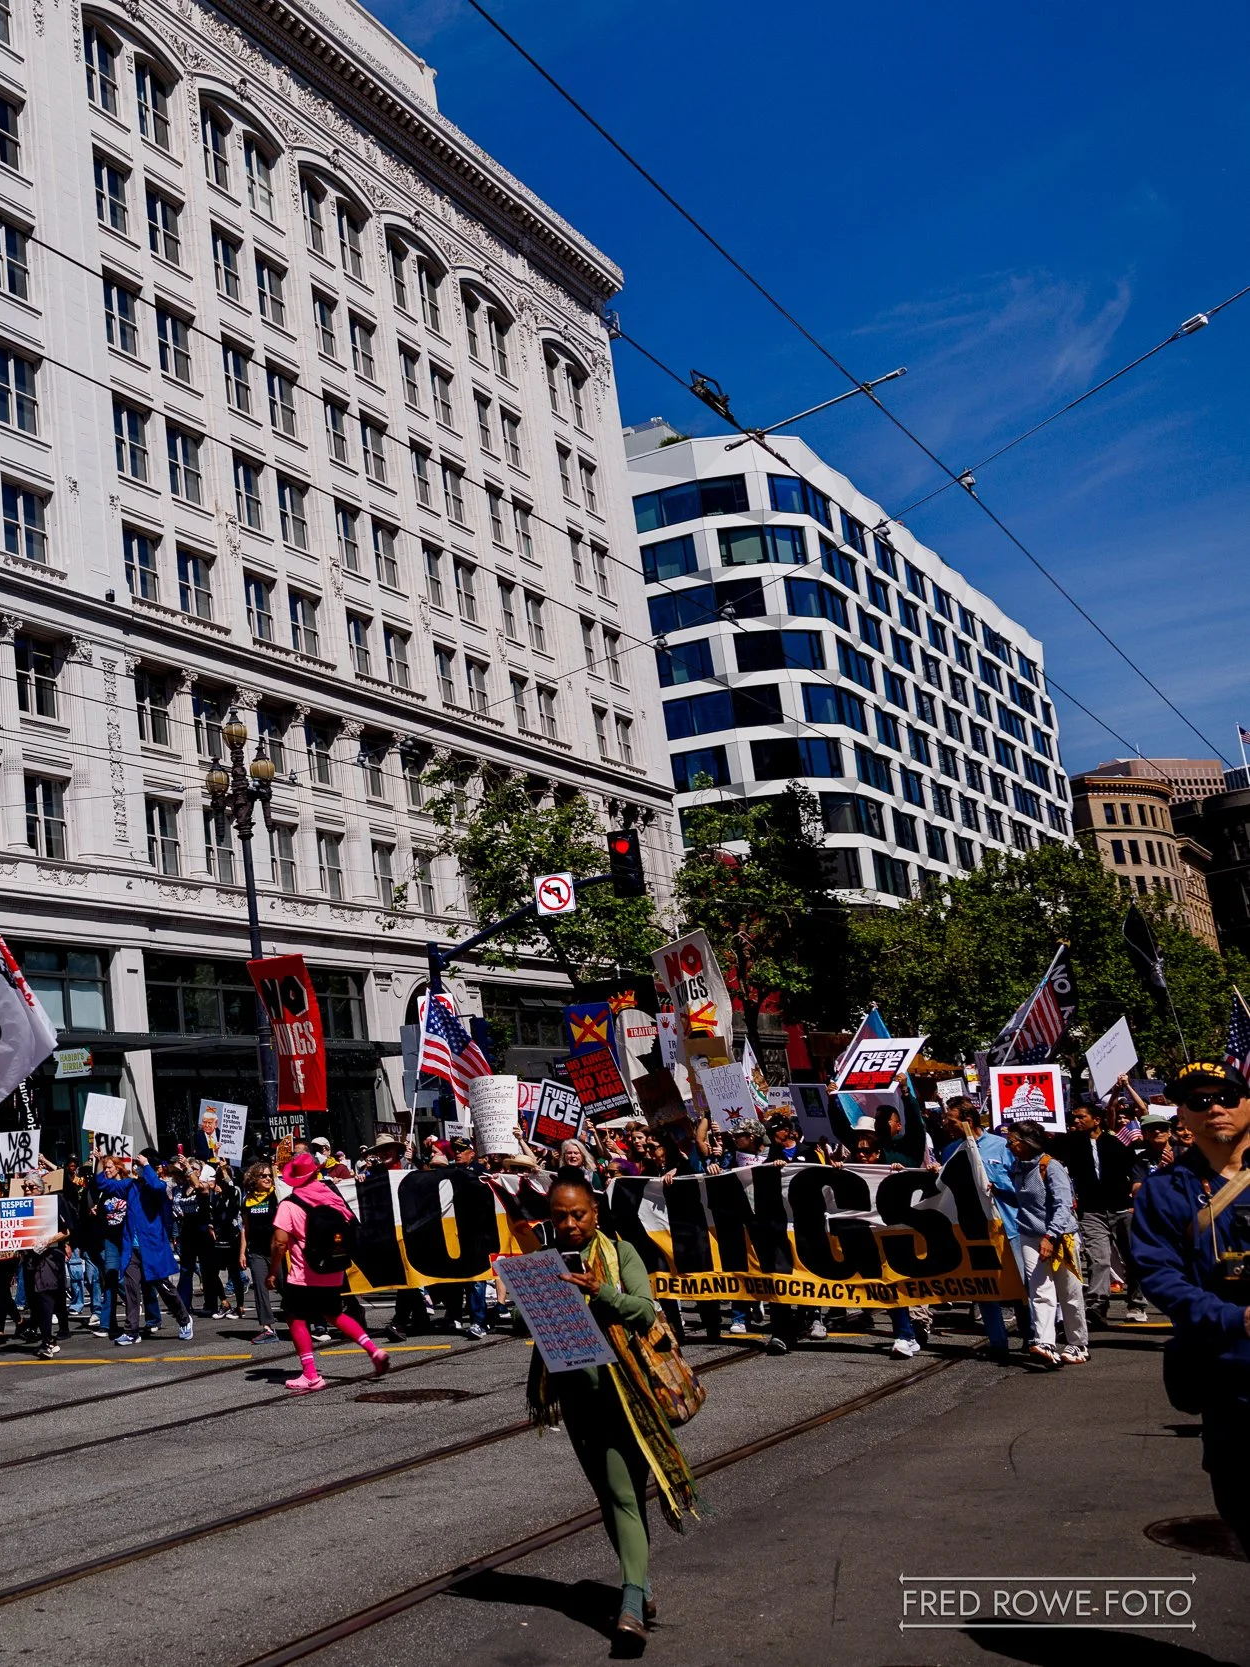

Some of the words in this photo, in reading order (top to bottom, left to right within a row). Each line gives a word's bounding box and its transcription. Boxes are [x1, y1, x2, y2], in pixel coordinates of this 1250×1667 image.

[663, 943, 704, 987] NO
[1050, 964, 1072, 994] NO
[260, 976, 309, 1020] NO
[675, 976, 708, 1008] KINGS
[273, 1020, 316, 1056] KINGS
[630, 1026, 658, 1036] TRAITOR
[60, 1052, 84, 1062] HABIBI'S
[565, 1059, 580, 1072] NO
[582, 1050, 610, 1066] KINGS
[859, 1051, 903, 1060] FUERA
[710, 1065, 733, 1078] EPIC
[851, 1058, 902, 1072] ICE
[1179, 1063, 1226, 1080] AMEL
[290, 1060, 304, 1094] SF
[573, 1076, 594, 1092] NO
[594, 1066, 620, 1085] ICE
[1003, 1076, 1049, 1086] STOP
[544, 1086, 582, 1108] FUERA
[578, 1089, 596, 1105] NO
[596, 1080, 625, 1099] WAR
[18, 1080, 36, 1130] ESIST
[540, 1096, 581, 1127] ICE
[269, 1116, 288, 1126] HEAR
[290, 1115, 304, 1124] OUR
[1015, 1110, 1053, 1118] BILLIONAIRE
[387, 1123, 402, 1134] YOU
[8, 1132, 31, 1149] NO
[0, 1149, 34, 1172] WAR
[1, 1200, 32, 1209] RESPECT
[1, 1220, 24, 1228] RULE
[2, 1230, 15, 1238] OF
[2, 1240, 22, 1248] LAW
[656, 1275, 741, 1295] DEMAND
[745, 1276, 861, 1304] DEMOCRACY,
[864, 1282, 898, 1302] NOT
[906, 1276, 1000, 1300] FASCISM!
